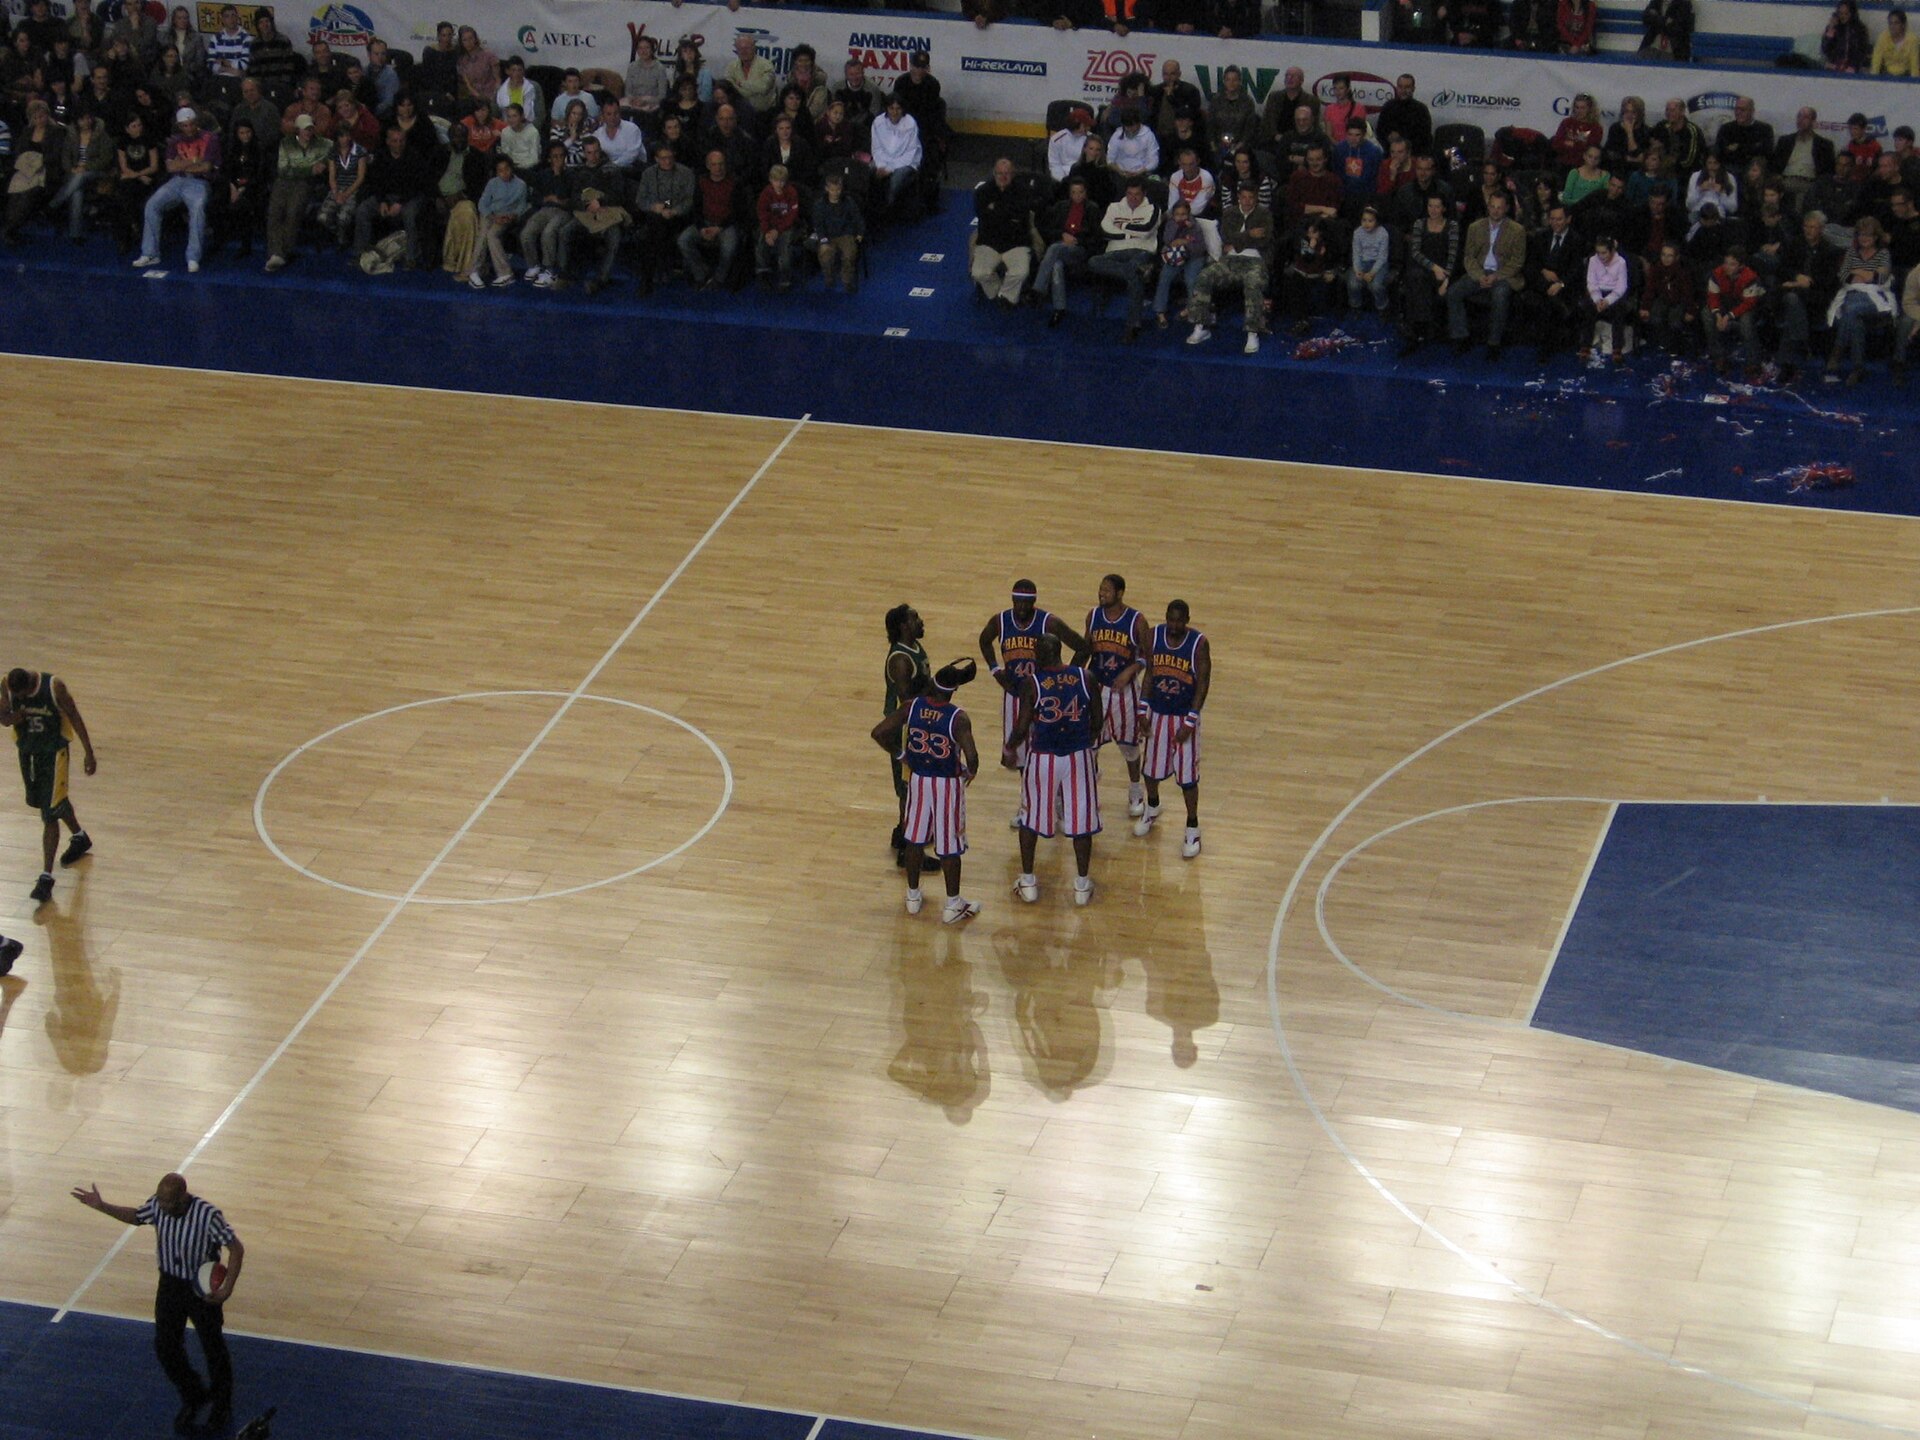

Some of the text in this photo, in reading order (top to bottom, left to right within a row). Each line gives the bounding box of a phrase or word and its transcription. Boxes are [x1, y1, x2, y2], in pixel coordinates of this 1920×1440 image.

[542, 33, 597, 48] AVET-C
[849, 33, 931, 51] AMERICAN
[848, 48, 909, 71] TAXI
[1004, 636, 1040, 650] HARLE
[1092, 629, 1129, 646] HARLEM
[1014, 661, 1036, 678] 40
[1099, 654, 1119, 671] 14
[1153, 654, 1190, 672] HARLEM
[1056, 672, 1080, 686] EASY
[1157, 679, 1180, 695] 42
[920, 708, 944, 722] LEFTY
[1039, 694, 1081, 723] 34
[907, 727, 951, 759] 33
